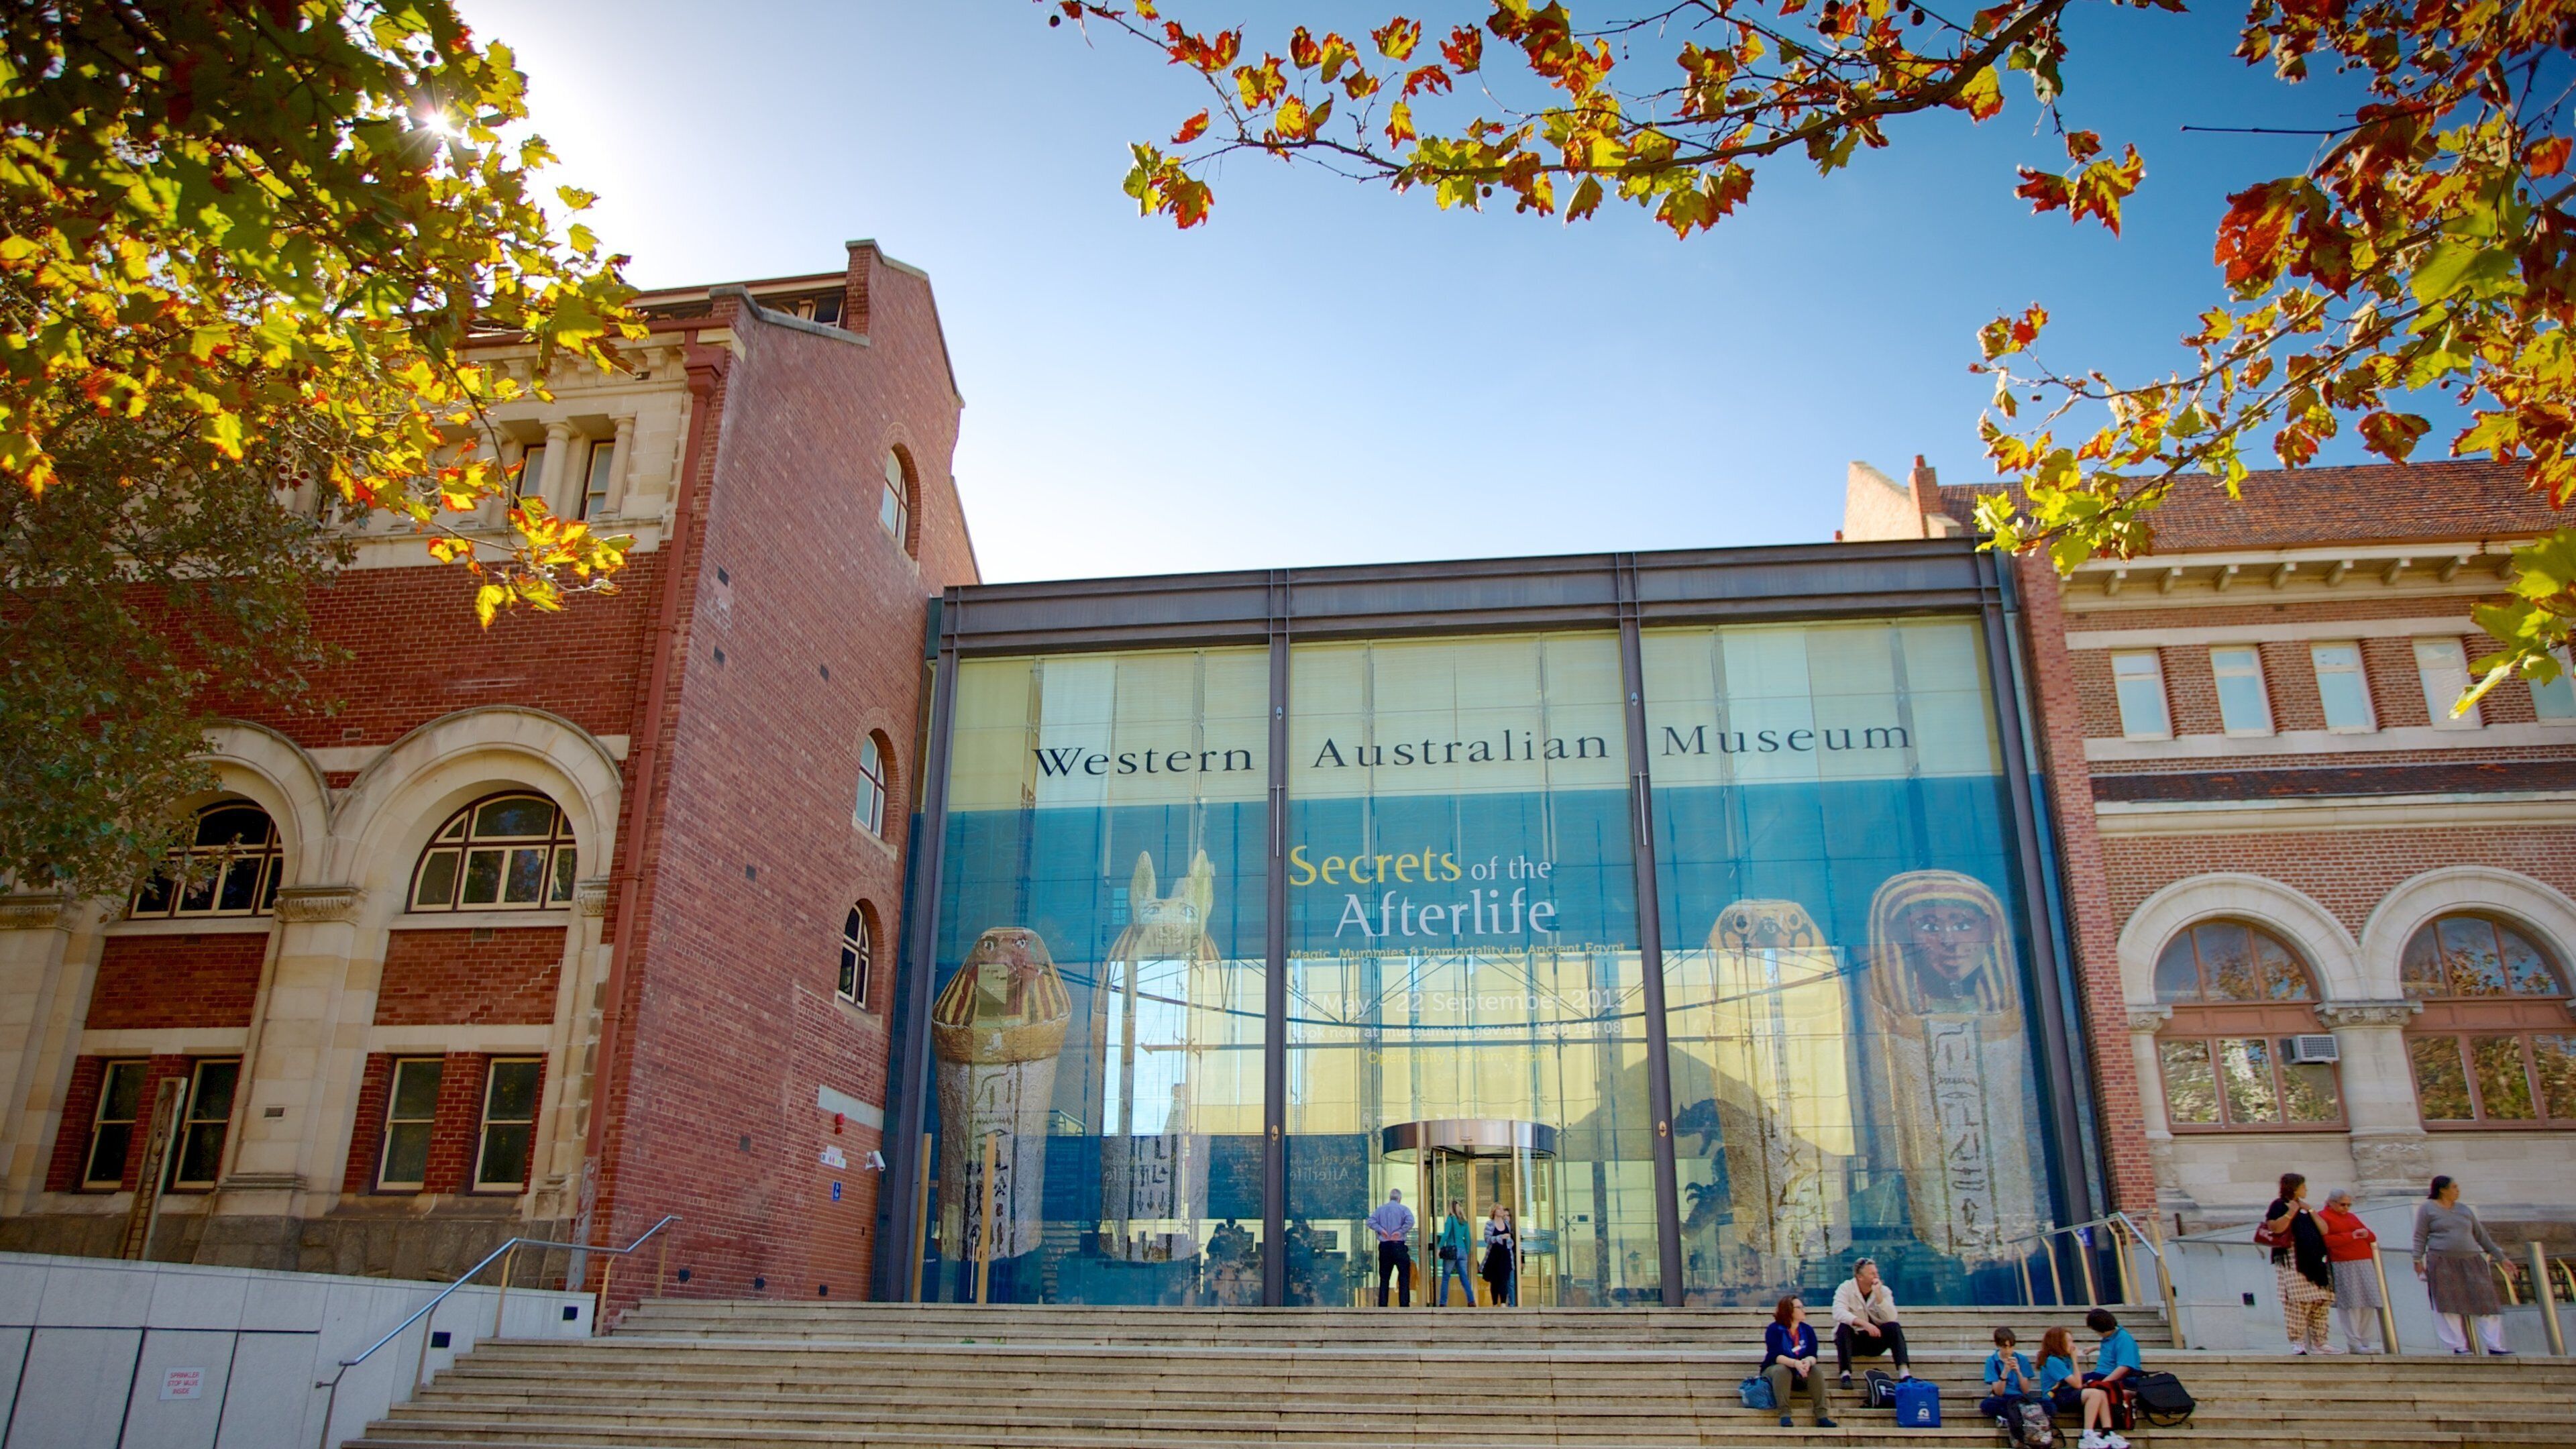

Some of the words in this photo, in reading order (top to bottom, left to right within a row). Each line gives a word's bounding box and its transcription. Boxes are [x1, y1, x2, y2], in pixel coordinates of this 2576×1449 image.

[1034, 747, 1255, 777] Western
[1310, 729, 1610, 768] Australian
[1660, 724, 1913, 756] Museum
[1289, 845, 1462, 887] Secrets
[1470, 855, 1499, 881] of
[1509, 855, 1552, 879] the
[1334, 888, 1556, 938] Afterlife
[1340, 948, 1405, 959] Mummies
[1409, 947, 1419, 957] &
[1423, 944, 1505, 958] Immortality
[1509, 944, 1522, 955] in
[1527, 943, 1580, 955] Ancient
[1585, 942, 1625, 957] Egypt
[1323, 994, 1371, 1019] May
[1395, 992, 1425, 1012] 22
[1433, 989, 1563, 1016] September
[1572, 989, 1629, 1010] 2013
[1293, 1026, 1326, 1039] ook
[1329, 1028, 1361, 1038] now
[1364, 1026, 1379, 1038] at
[1603, 1021, 1630, 1034] 081
[1367, 1051, 1407, 1066] Open
